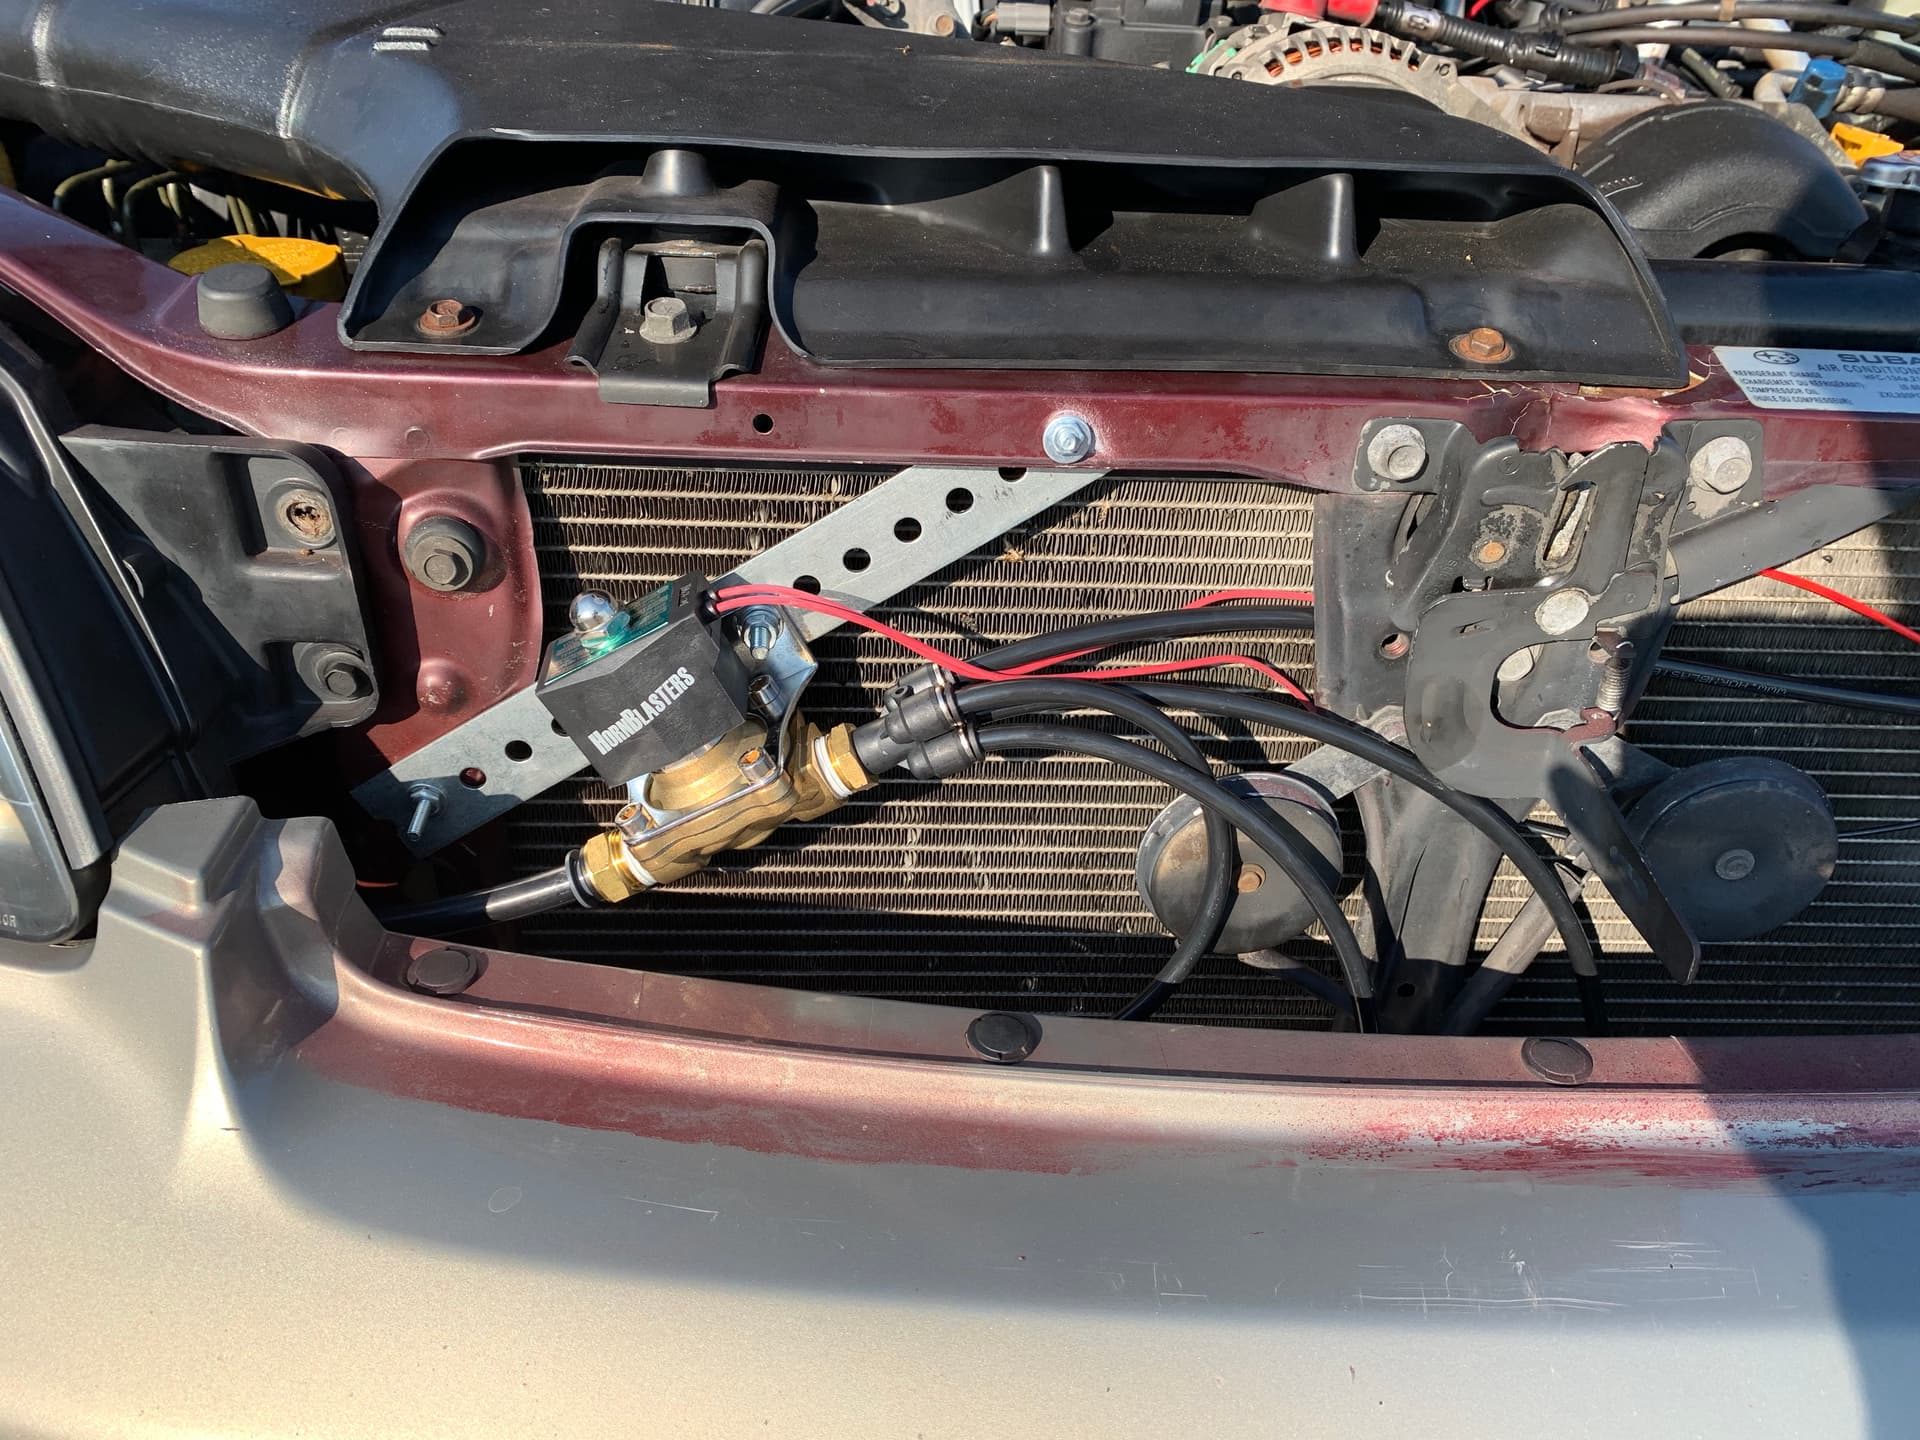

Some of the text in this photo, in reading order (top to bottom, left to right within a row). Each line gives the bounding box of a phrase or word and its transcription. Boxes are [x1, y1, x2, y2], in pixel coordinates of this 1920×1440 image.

[1733, 369, 1823, 379] REFRIGERANT CHARGE
[1817, 363, 1920, 375] AIR CONDITION
